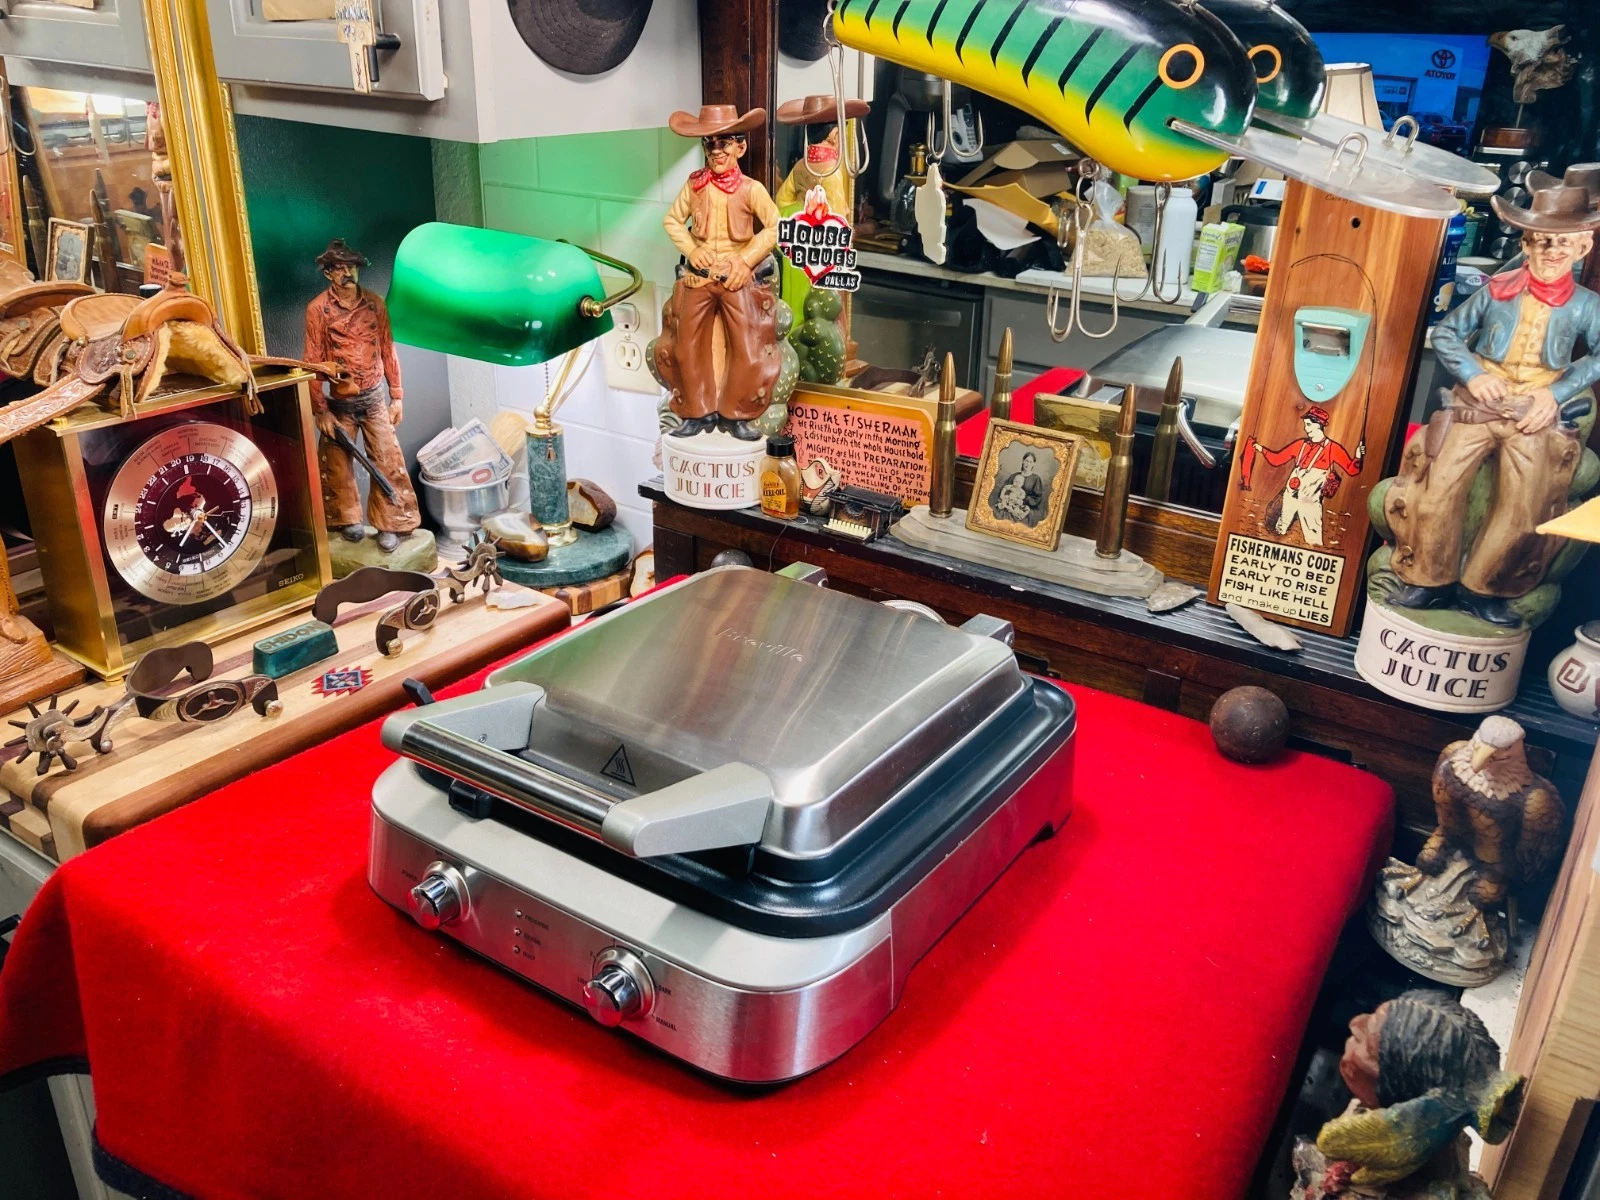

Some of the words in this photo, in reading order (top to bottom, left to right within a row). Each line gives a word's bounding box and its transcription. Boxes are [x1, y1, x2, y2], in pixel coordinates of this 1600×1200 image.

[781, 223, 848, 245] HOUSE
[795, 250, 854, 264] BLUES
[824, 276, 856, 287] DALLAS
[843, 414, 917, 439] FISHERMAN
[863, 442, 882, 453] whole
[885, 436, 921, 450] Morning
[669, 455, 755, 479] CACTUS
[841, 458, 867, 469] FORTH
[871, 465, 888, 474] FULL
[904, 471, 925, 482] HOPE
[864, 451, 927, 473] PREPARATIONS
[675, 477, 745, 500] JUICE
[855, 470, 876, 479] WHEN
[879, 473, 893, 483] THE
[896, 476, 912, 486] DAY
[892, 484, 902, 492] OF
[1230, 537, 1304, 566] FISHERMANS
[1307, 554, 1338, 573] CODE
[278, 573, 304, 587] SEIKO
[1229, 566, 1271, 583] EARLY
[1275, 576, 1292, 588] TO
[1295, 581, 1328, 596] RISE
[1231, 554, 1277, 571] EARLY
[1283, 565, 1301, 577] TO
[1305, 571, 1335, 585] BED
[1224, 578, 1254, 593] FISH
[1259, 586, 1290, 601] LIKE
[1293, 594, 1329, 611] HELL
[1220, 592, 1243, 603] and
[1247, 598, 1280, 612] make
[1282, 606, 1297, 616] up
[1298, 608, 1330, 623] LIES
[1379, 628, 1511, 674] CACTUS
[1381, 658, 1490, 699] JUICE
[655, 1016, 677, 1032] MANUAL
